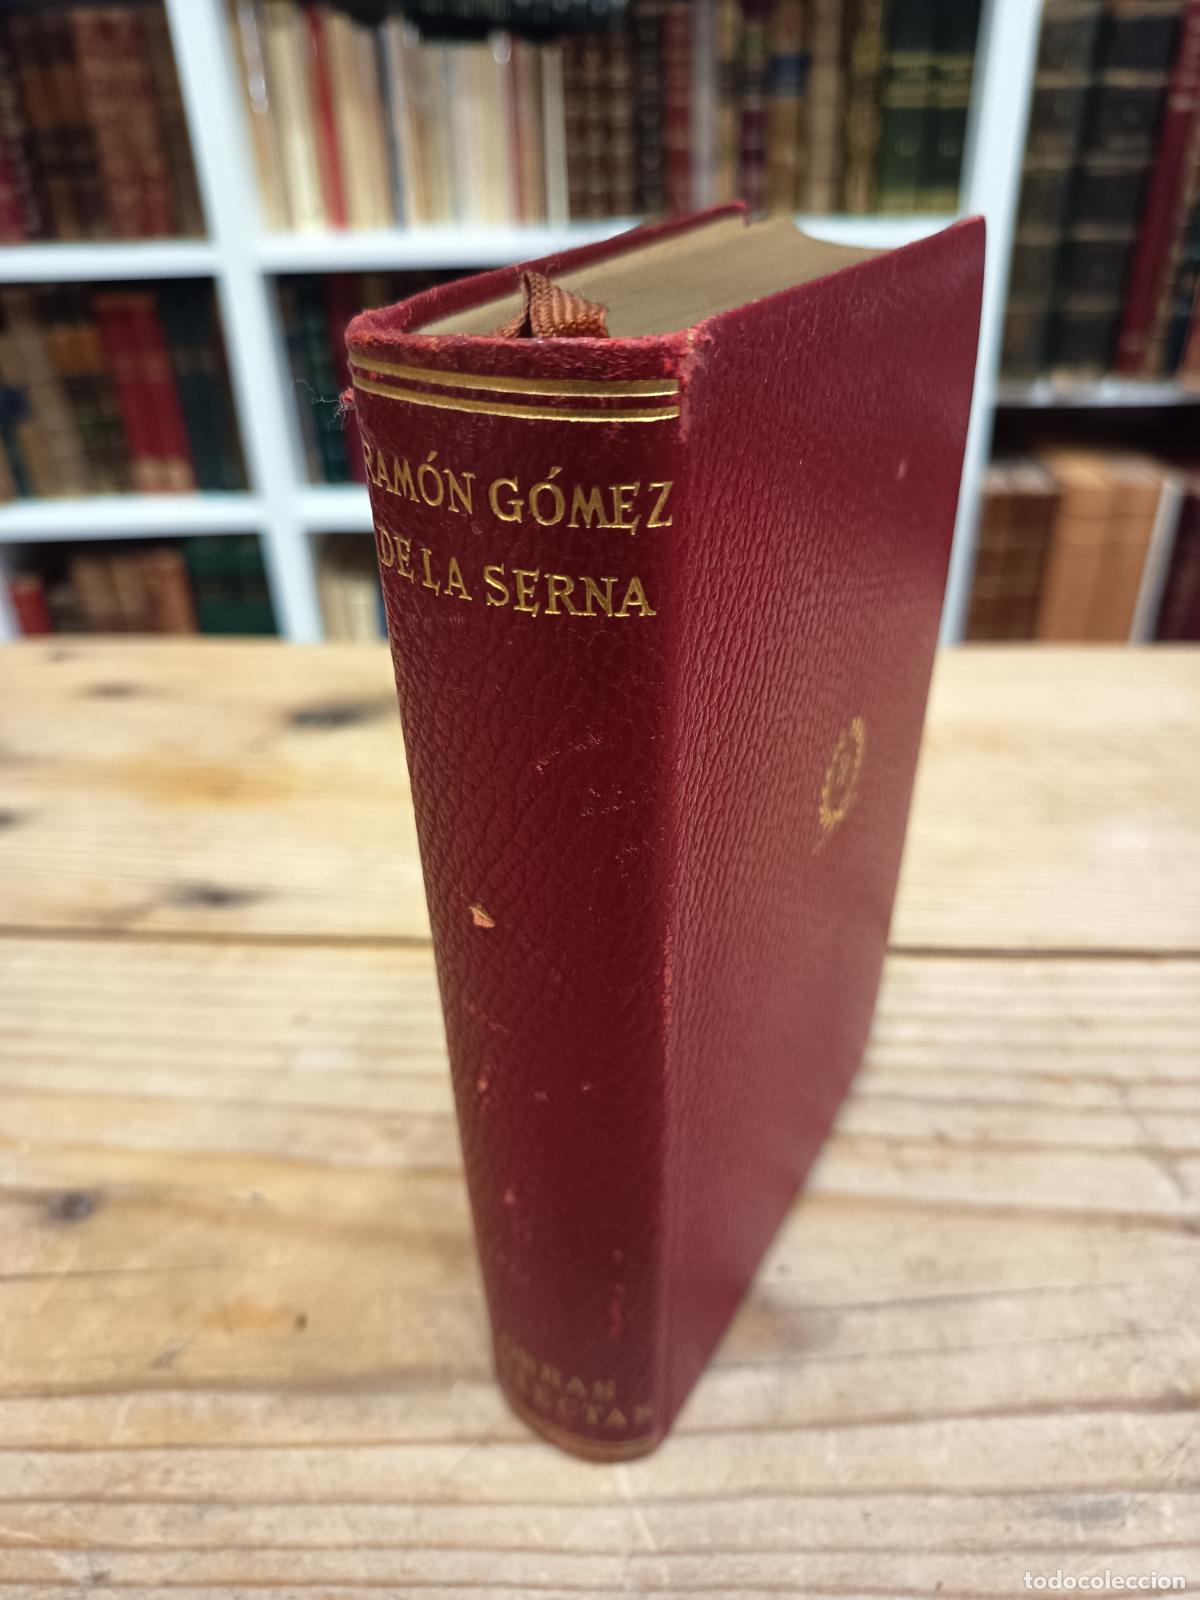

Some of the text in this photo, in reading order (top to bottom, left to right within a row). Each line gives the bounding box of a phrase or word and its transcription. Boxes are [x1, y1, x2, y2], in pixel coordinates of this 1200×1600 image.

[363, 442, 674, 535] RAMÓN GÓMEZ
[377, 526, 657, 617] DE LA SERNA
